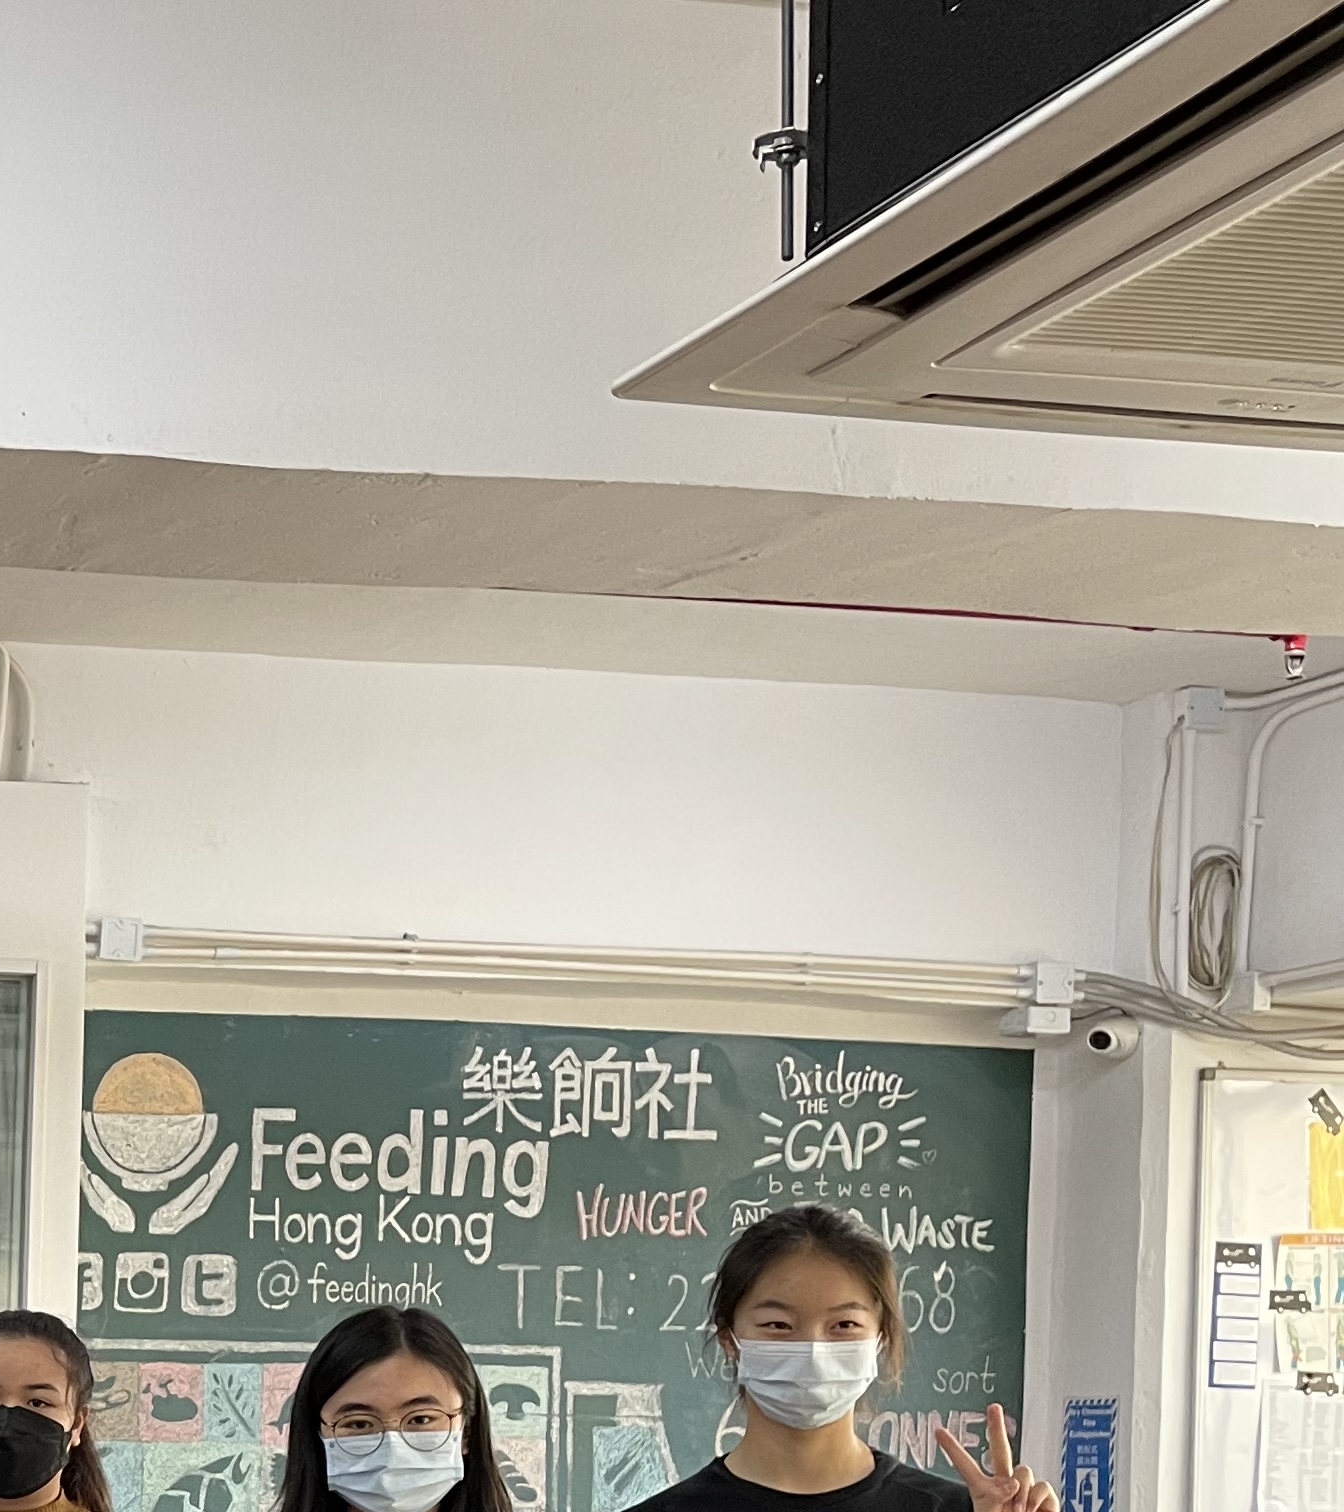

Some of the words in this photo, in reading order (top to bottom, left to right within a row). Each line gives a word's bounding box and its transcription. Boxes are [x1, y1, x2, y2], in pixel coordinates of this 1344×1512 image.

[462, 1045, 718, 1142] 樂餉社
[775, 1049, 919, 1109] Bridging
[796, 1098, 829, 1116] THE
[250, 1107, 550, 1218] Feeding
[784, 1119, 889, 1172] GAP
[767, 1173, 913, 1199] between
[248, 1197, 362, 1260] Hong
[377, 1194, 494, 1265] Kong
[575, 1183, 709, 1241] HUNGER
[880, 1205, 995, 1254] WASTE
[496, 1263, 637, 1332] TEL:
[932, 1355, 996, 1396] sort
